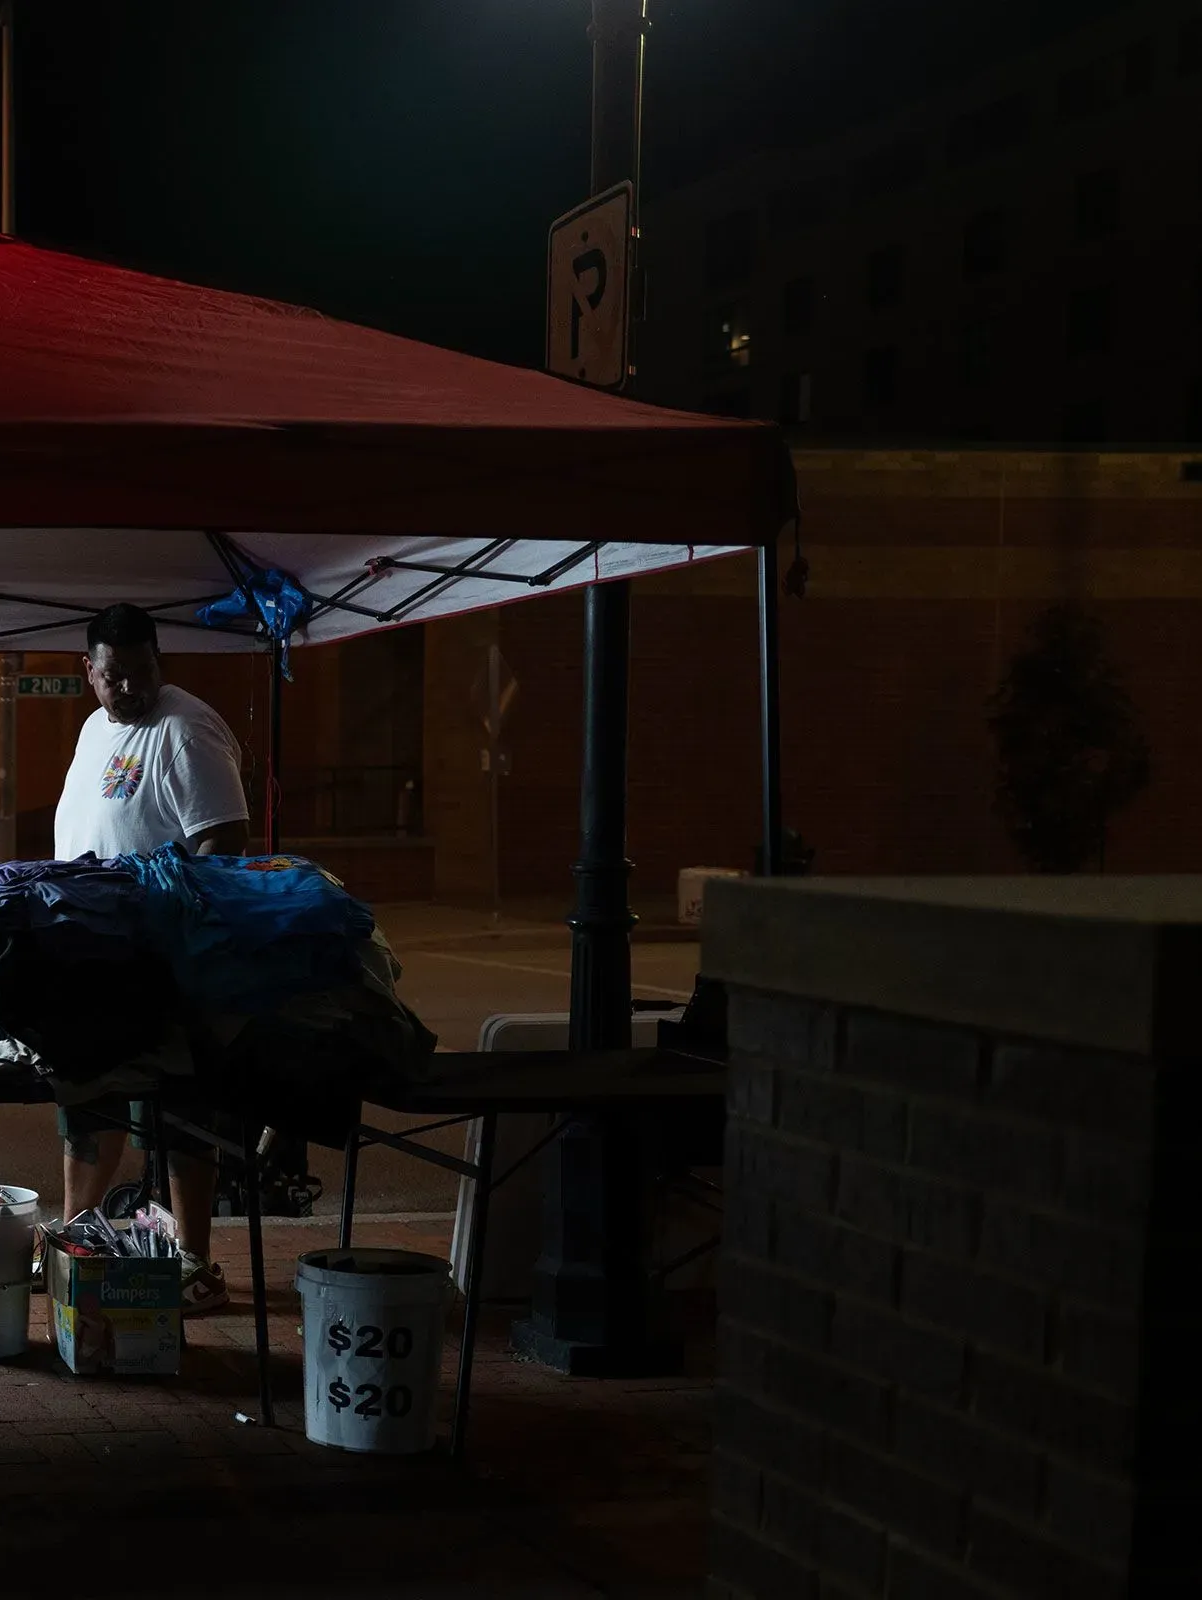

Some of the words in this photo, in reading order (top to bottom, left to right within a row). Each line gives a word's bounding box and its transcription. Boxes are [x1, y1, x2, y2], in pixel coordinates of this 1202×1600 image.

[31, 677, 62, 694] 2ND
[101, 1280, 160, 1303] Pampers
[328, 1321, 412, 1359] $20
[328, 1377, 412, 1418] $20
